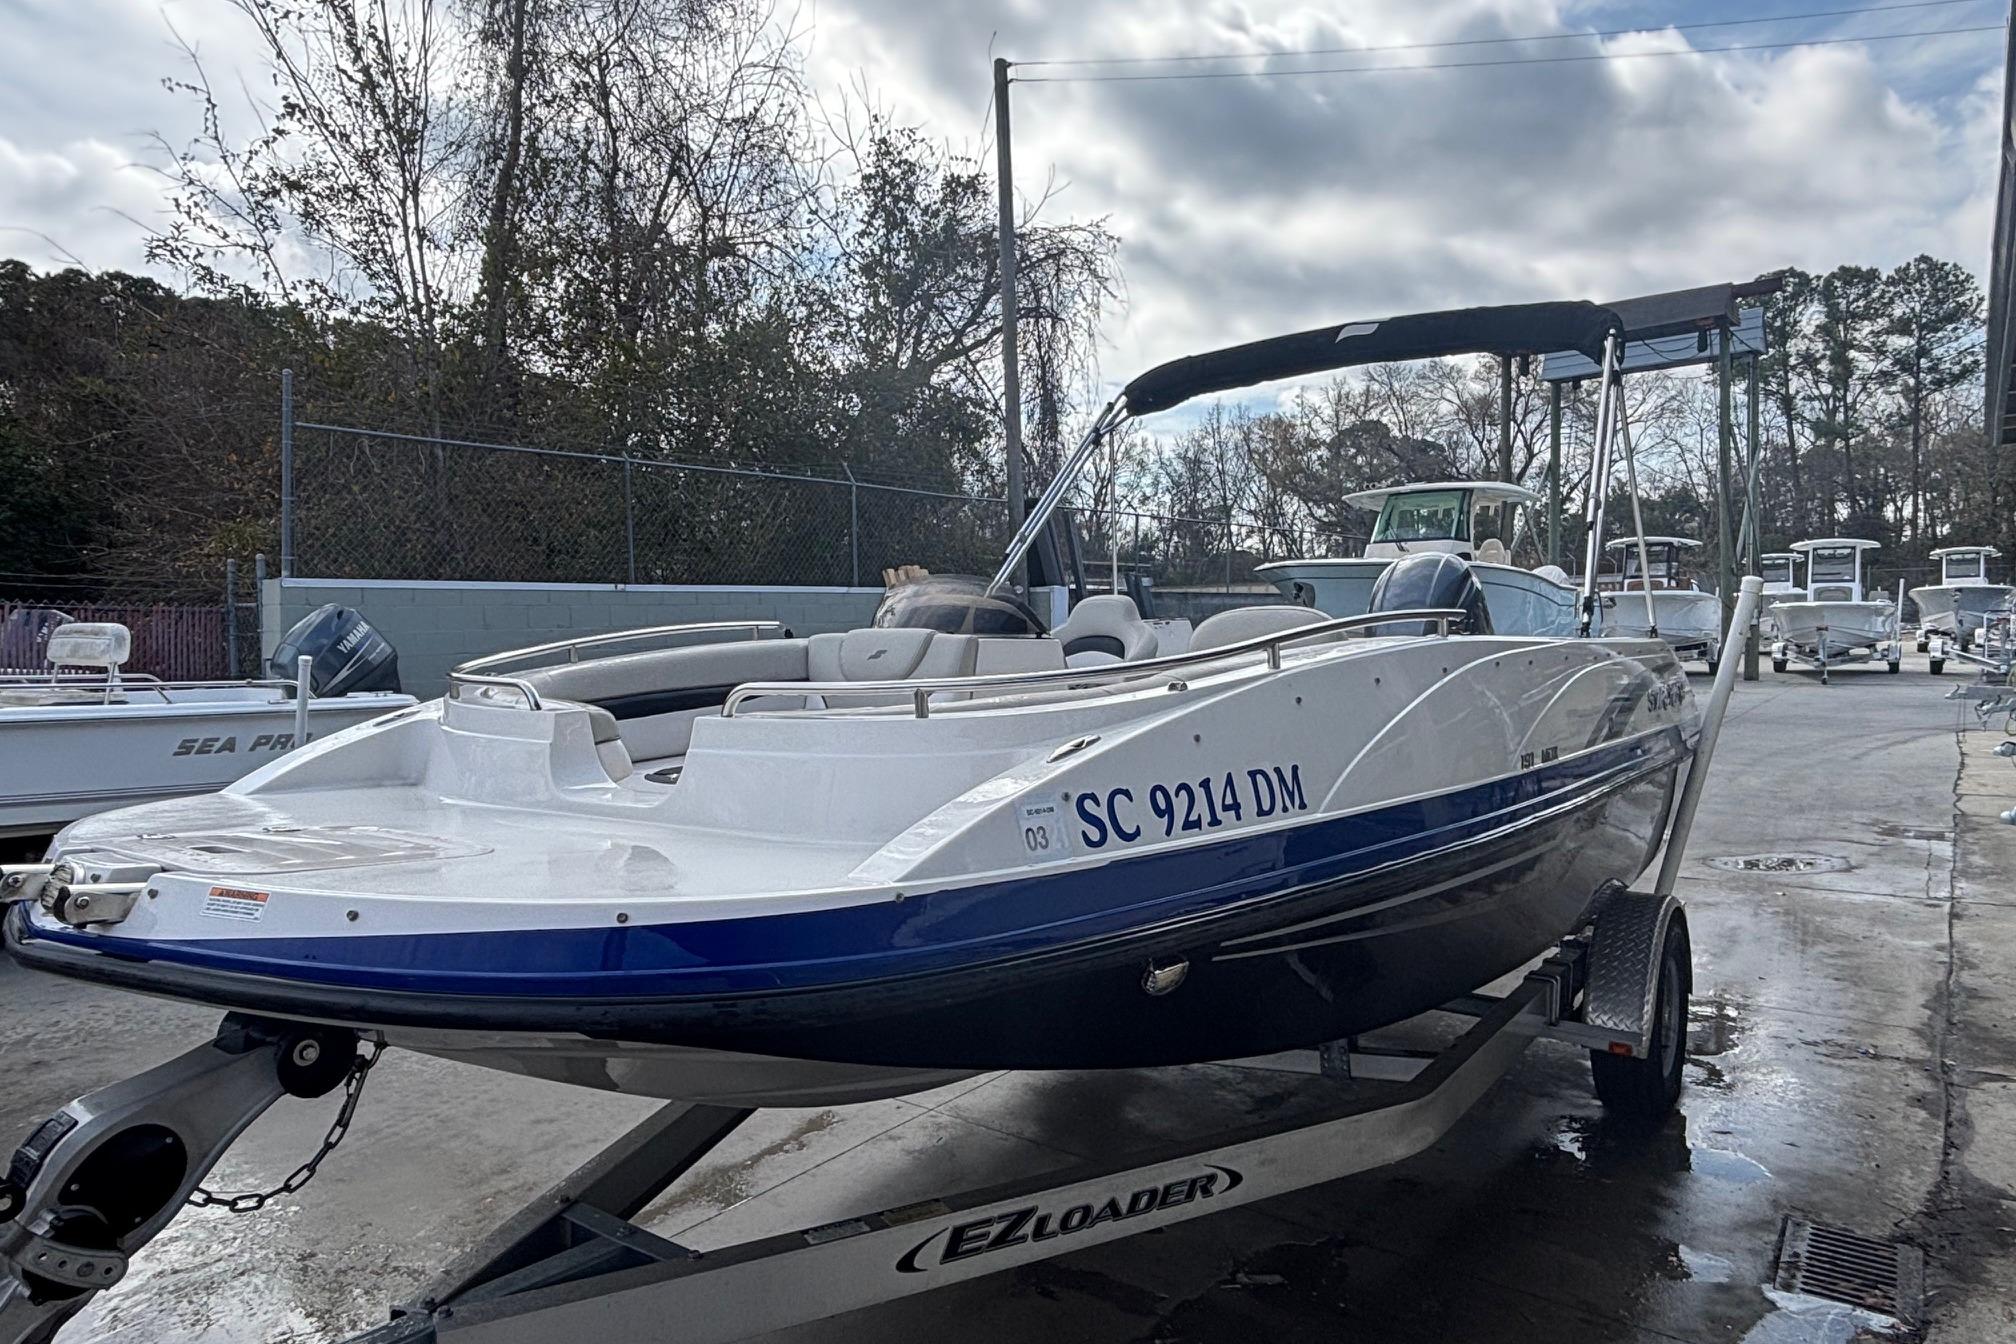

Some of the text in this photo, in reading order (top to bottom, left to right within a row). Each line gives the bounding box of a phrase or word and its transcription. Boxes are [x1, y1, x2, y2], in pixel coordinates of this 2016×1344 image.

[337, 621, 370, 653] YAMAHA
[172, 736, 237, 757] SEA
[1075, 763, 1308, 849] SC 9214 DM
[1025, 825, 1050, 852] 03
